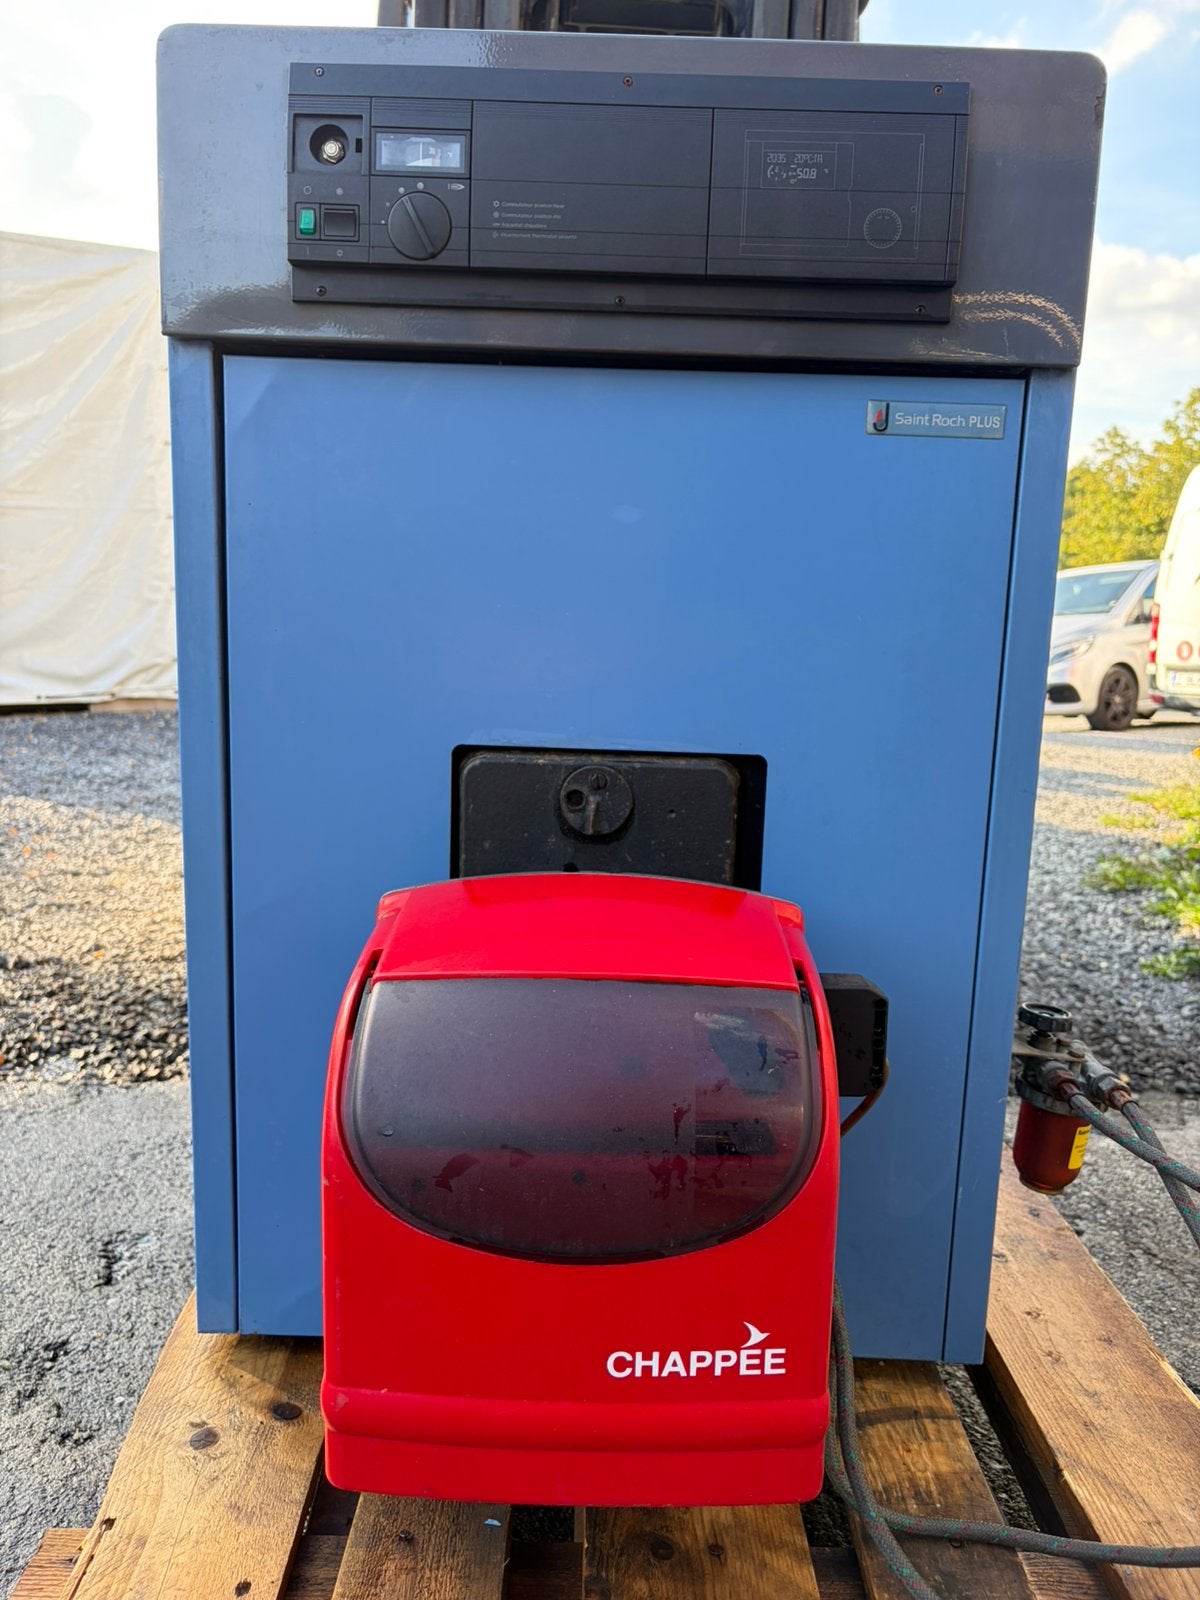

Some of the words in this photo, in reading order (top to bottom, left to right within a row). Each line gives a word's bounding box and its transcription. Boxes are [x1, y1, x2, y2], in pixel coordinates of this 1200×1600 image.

[895, 412, 930, 426] Saint
[931, 413, 966, 427] Roch
[968, 415, 1001, 429] PLUS
